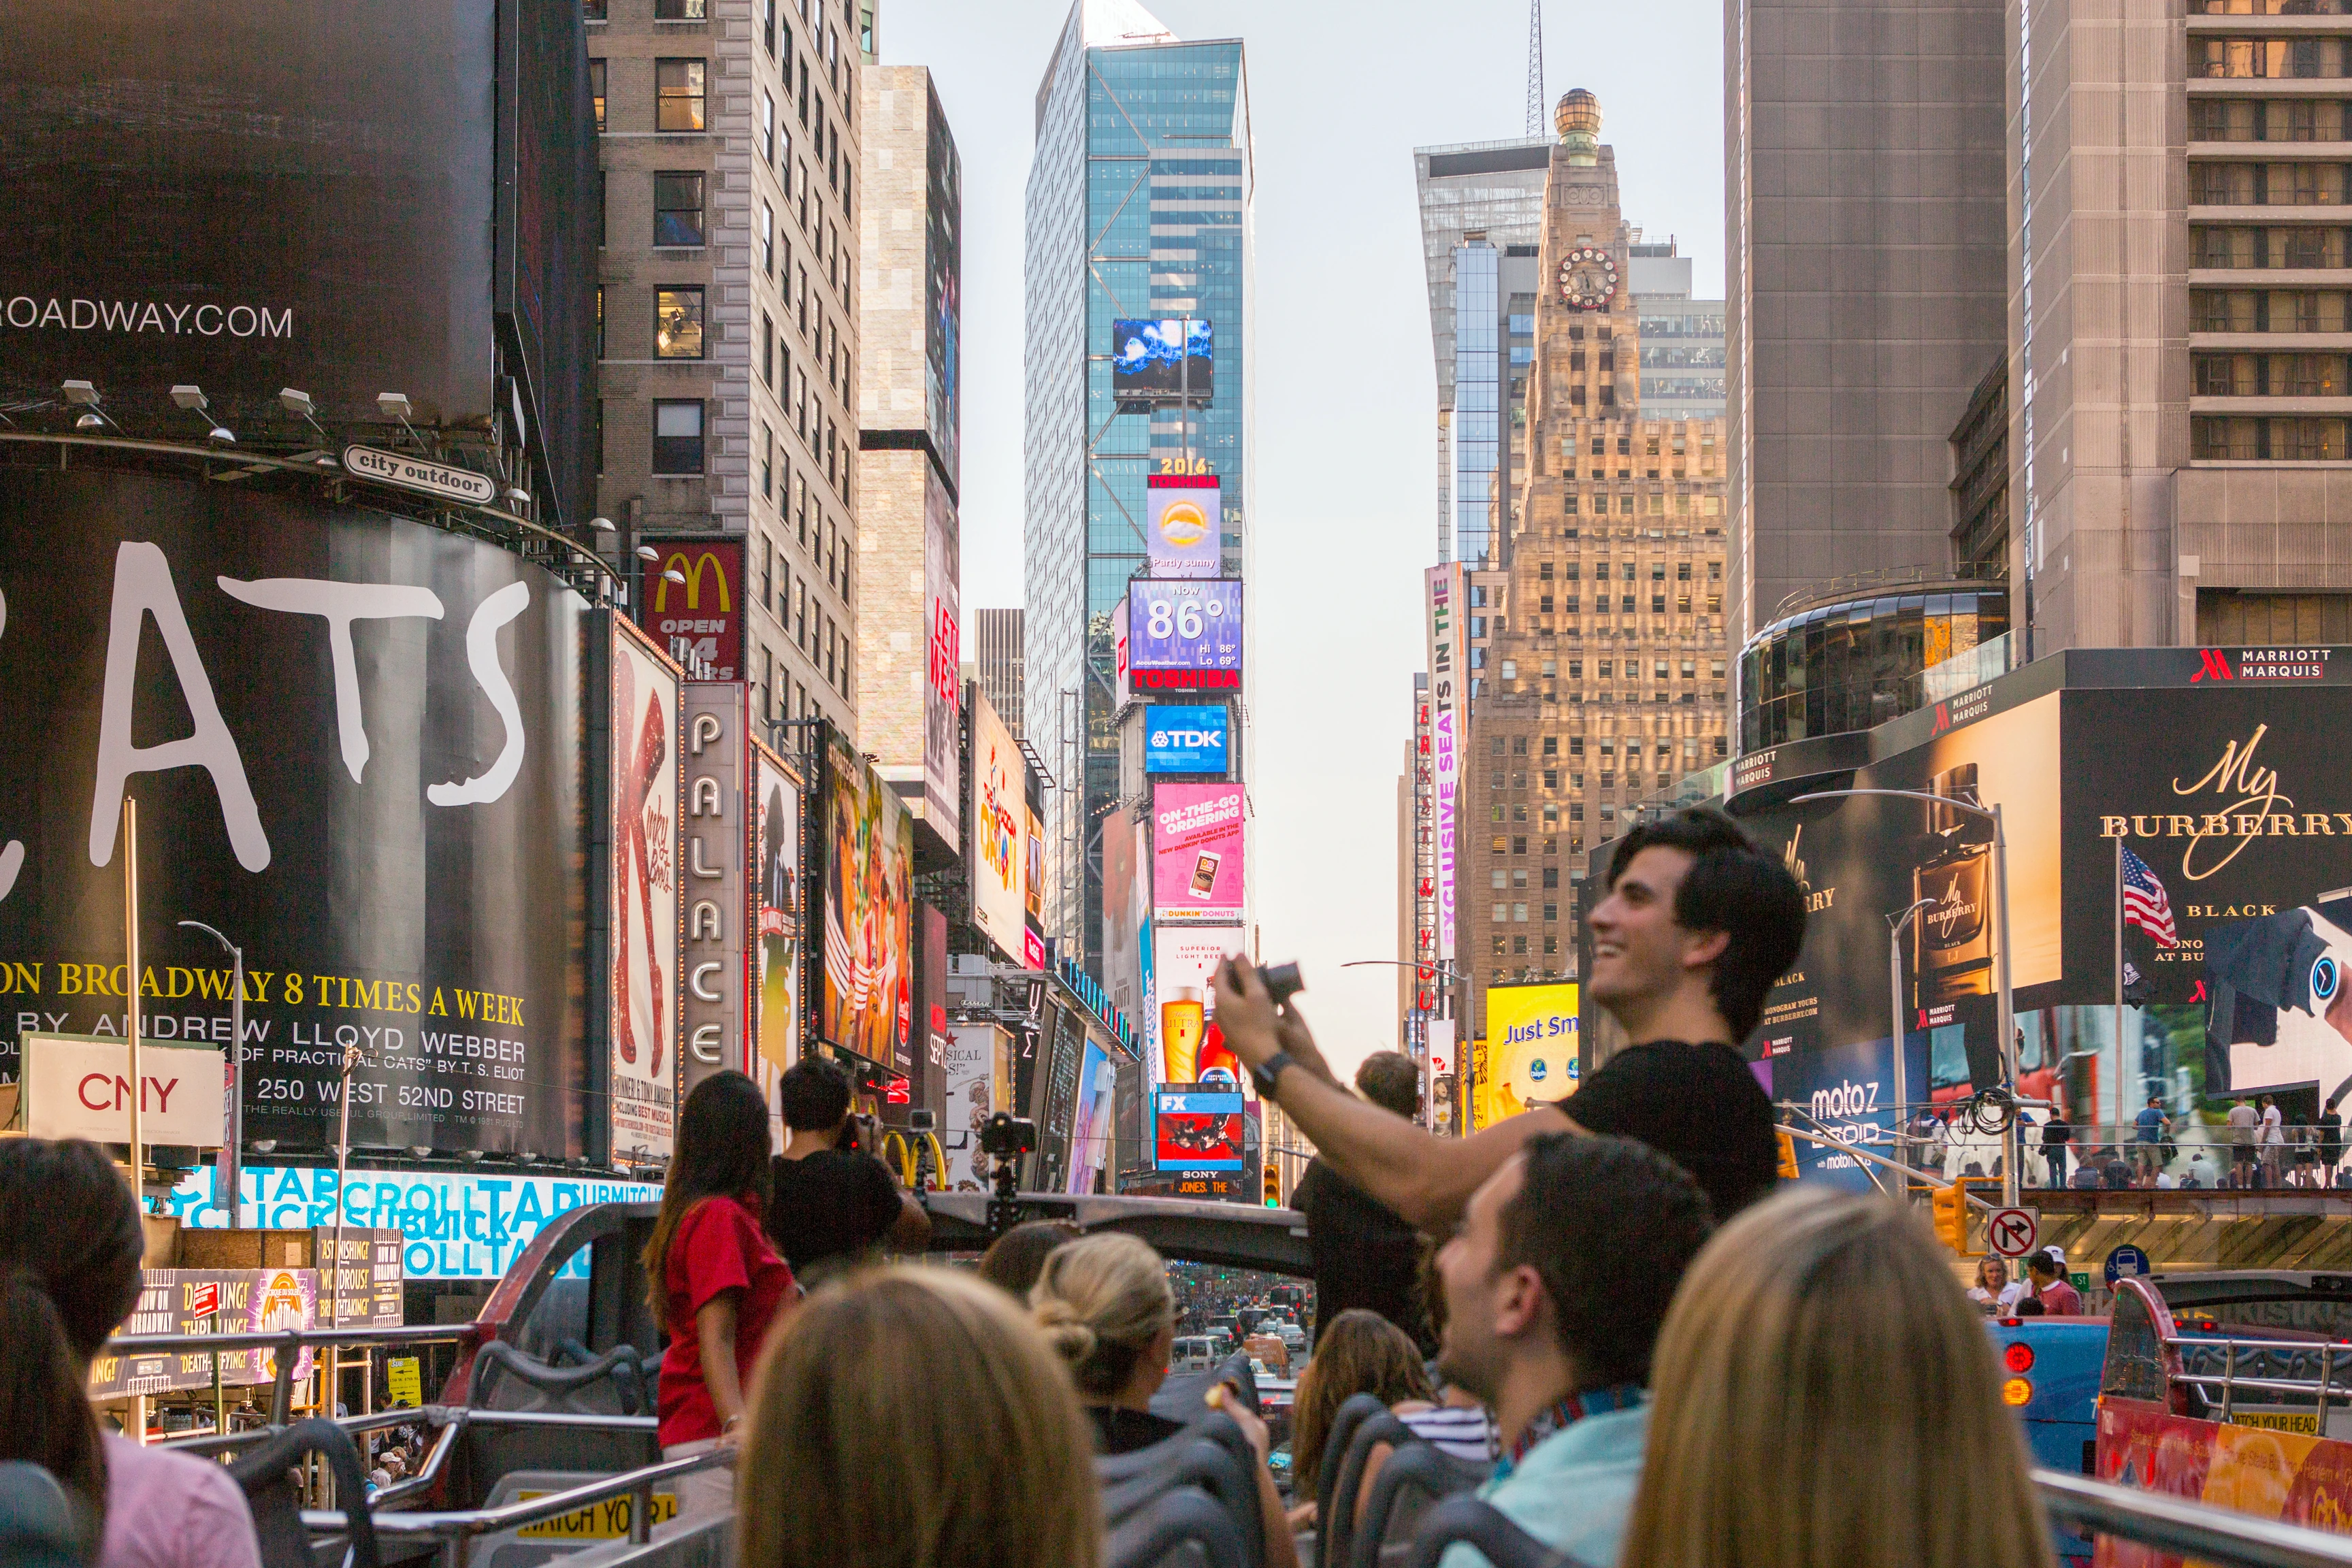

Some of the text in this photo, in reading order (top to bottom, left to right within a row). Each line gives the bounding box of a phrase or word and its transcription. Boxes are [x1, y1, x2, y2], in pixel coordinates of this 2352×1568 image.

[0, 296, 292, 338] OADWAY.COM
[359, 454, 483, 493] city outdoor
[1160, 457, 1207, 474] 2016
[1149, 476, 1219, 488] TOSHIBA
[1154, 558, 1215, 568] Partly sunny
[1173, 585, 1200, 595] Now
[660, 619, 726, 634] OPEN
[1147, 599, 1224, 640] 86°
[1200, 644, 1237, 654] Hi 86°
[2242, 650, 2332, 662] MARRIOTT
[1200, 656, 1237, 666] Lo 69°
[2242, 665, 2321, 677] MARQUIS
[1130, 669, 1241, 689] TOSHIBA
[1953, 685, 1993, 709] MARRIOTT
[0, 541, 532, 900] ATS
[1953, 701, 1988, 723] MARQUIS
[1167, 730, 1222, 747] TDK
[1433, 578, 1455, 946] EXCLUSIVE SEATS IN THE
[1735, 751, 1776, 774] MARRIOTT
[1735, 767, 1770, 789] MARQUIS
[1159, 794, 1240, 824] ON-THE-GO
[2172, 723, 2294, 881] My
[1166, 806, 1240, 835] ORDERING
[1185, 829, 1218, 842] AVAILABLE
[1226, 822, 1239, 830] THE
[1158, 847, 1173, 855] NEW
[1200, 833, 1226, 845] DONUTS
[1226, 830, 1239, 838] APP
[689, 711, 724, 1065] PALACE
[1419, 876, 1434, 897] &
[1927, 902, 1976, 924] BURBERRY
[1940, 872, 1964, 938] My
[2185, 904, 2277, 917] BLACK
[1944, 941, 1961, 949] BLACK
[2154, 953, 2176, 961] AT
[1774, 971, 1805, 987] BLACK
[57, 963, 275, 1002] BROADWAY
[284, 973, 304, 1004] 8
[313, 975, 421, 1014] TIMES
[428, 987, 448, 1017] A
[454, 989, 525, 1027] WEEK
[1764, 997, 1818, 1015] MONOGRAM YOURS
[1772, 1007, 1818, 1024] BURBERRY.COM
[1929, 1004, 1955, 1015] MARRIOTT
[1166, 1019, 1200, 1028] ULTRA
[1929, 1014, 1953, 1025] MARQUIS
[17, 1012, 525, 1064] BY ANDREW LLOYD WEBBER
[1503, 1019, 1544, 1045] Just
[1772, 1036, 1793, 1046] MARRIOTT
[1772, 1045, 1791, 1054] MARQUIS
[242, 1049, 263, 1062] OF
[273, 1049, 377, 1068] PRACTICAL
[437, 1060, 457, 1074] BY
[461, 1062, 472, 1074] T.
[478, 1064, 489, 1077] S.
[494, 1065, 525, 1081] ELIOT
[78, 1073, 179, 1113] CNY
[257, 1079, 525, 1115] 250 WEST 52ND STREET
[640, 1081, 653, 1105] TONY
[653, 1084, 672, 1110] AWARDS
[615, 1100, 672, 1125] INCLUDING BEST MUSICAL
[1161, 1096, 1187, 1111] FX
[243, 1105, 268, 1114] THE
[272, 1107, 316, 1116] REALLY
[367, 1110, 405, 1120] GROUP
[408, 1112, 445, 1124] LIMITED
[454, 1115, 468, 1124] TM
[478, 1117, 495, 1126] 1981
[495, 1119, 511, 1128] RUG
[512, 1120, 524, 1129] LTD
[1182, 1171, 1219, 1179] SONY
[1211, 1181, 1228, 1193] THE
[378, 1247, 397, 1262] NOW ON
[374, 1264, 400, 1281] BROADWAY
[2078, 1276, 2087, 1285] St
[138, 1290, 168, 1311] NOW ON
[268, 1288, 282, 1298] CIRQUE
[131, 1311, 174, 1335] BROADWAY
[2262, 1415, 2317, 1433] YOUR HEAD
